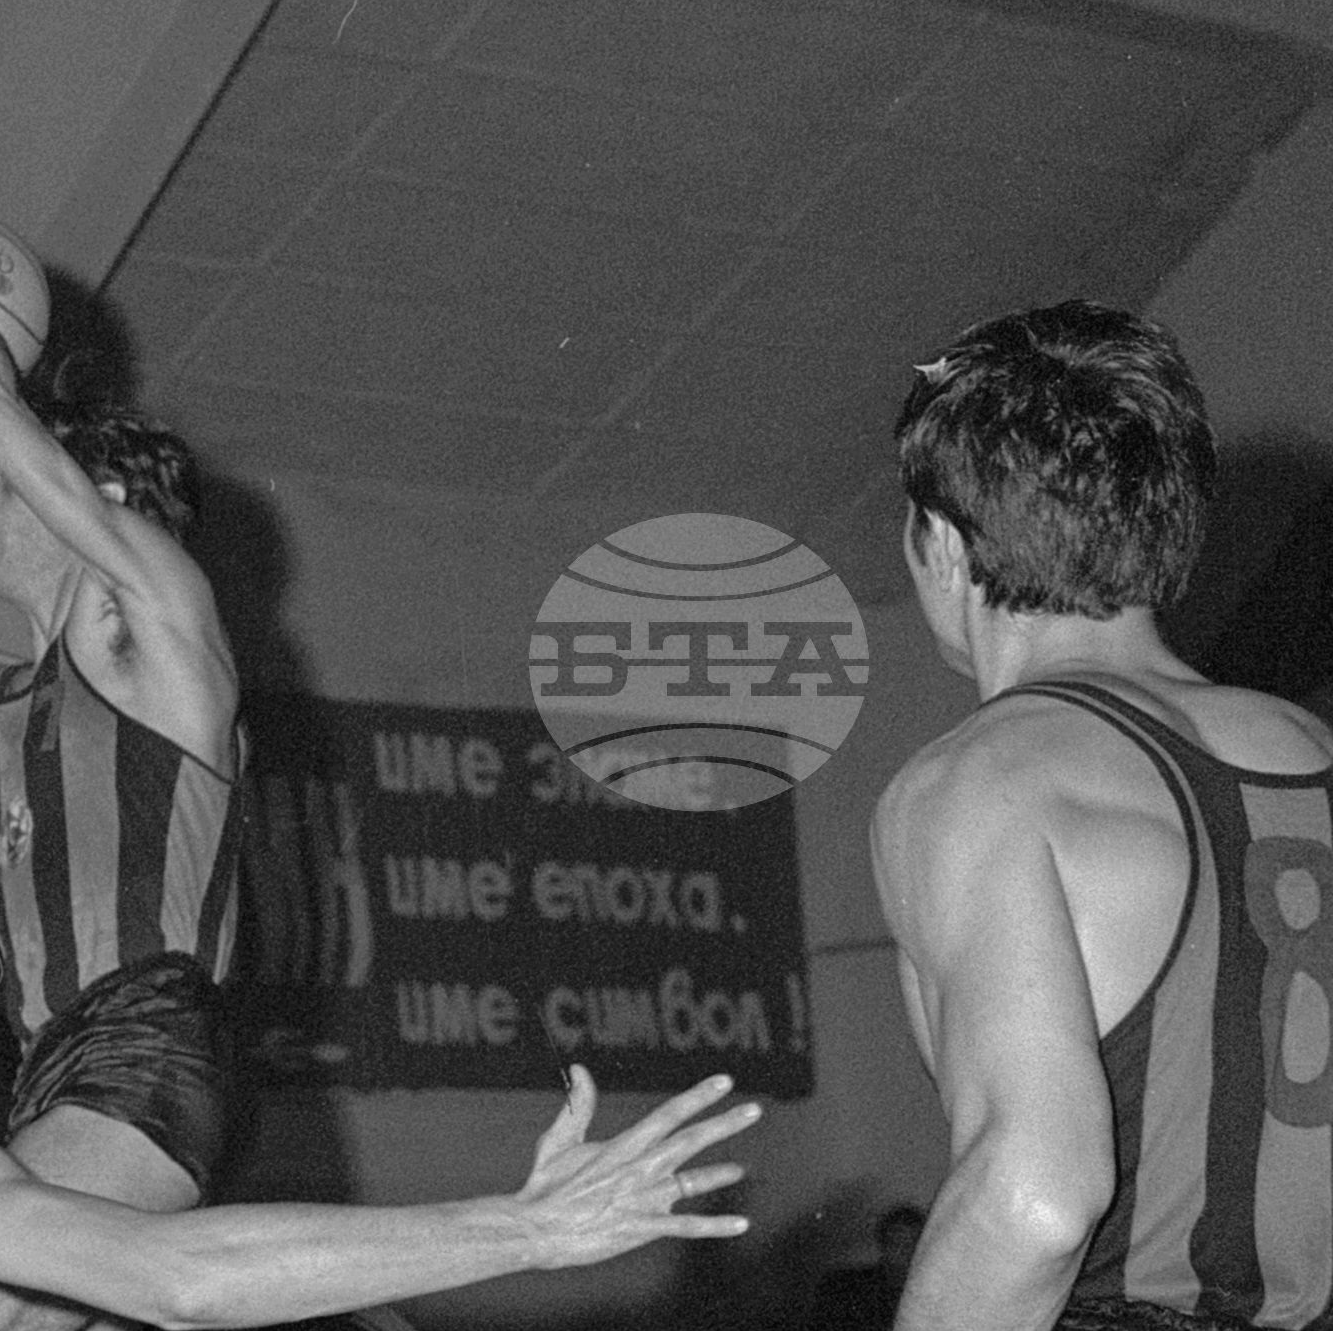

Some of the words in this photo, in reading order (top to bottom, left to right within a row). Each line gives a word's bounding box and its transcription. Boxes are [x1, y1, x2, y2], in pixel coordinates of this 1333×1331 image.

[374, 732, 504, 798] име
[386, 856, 511, 921] име
[398, 981, 519, 1046] име
[1244, 836, 1333, 1128] 8
